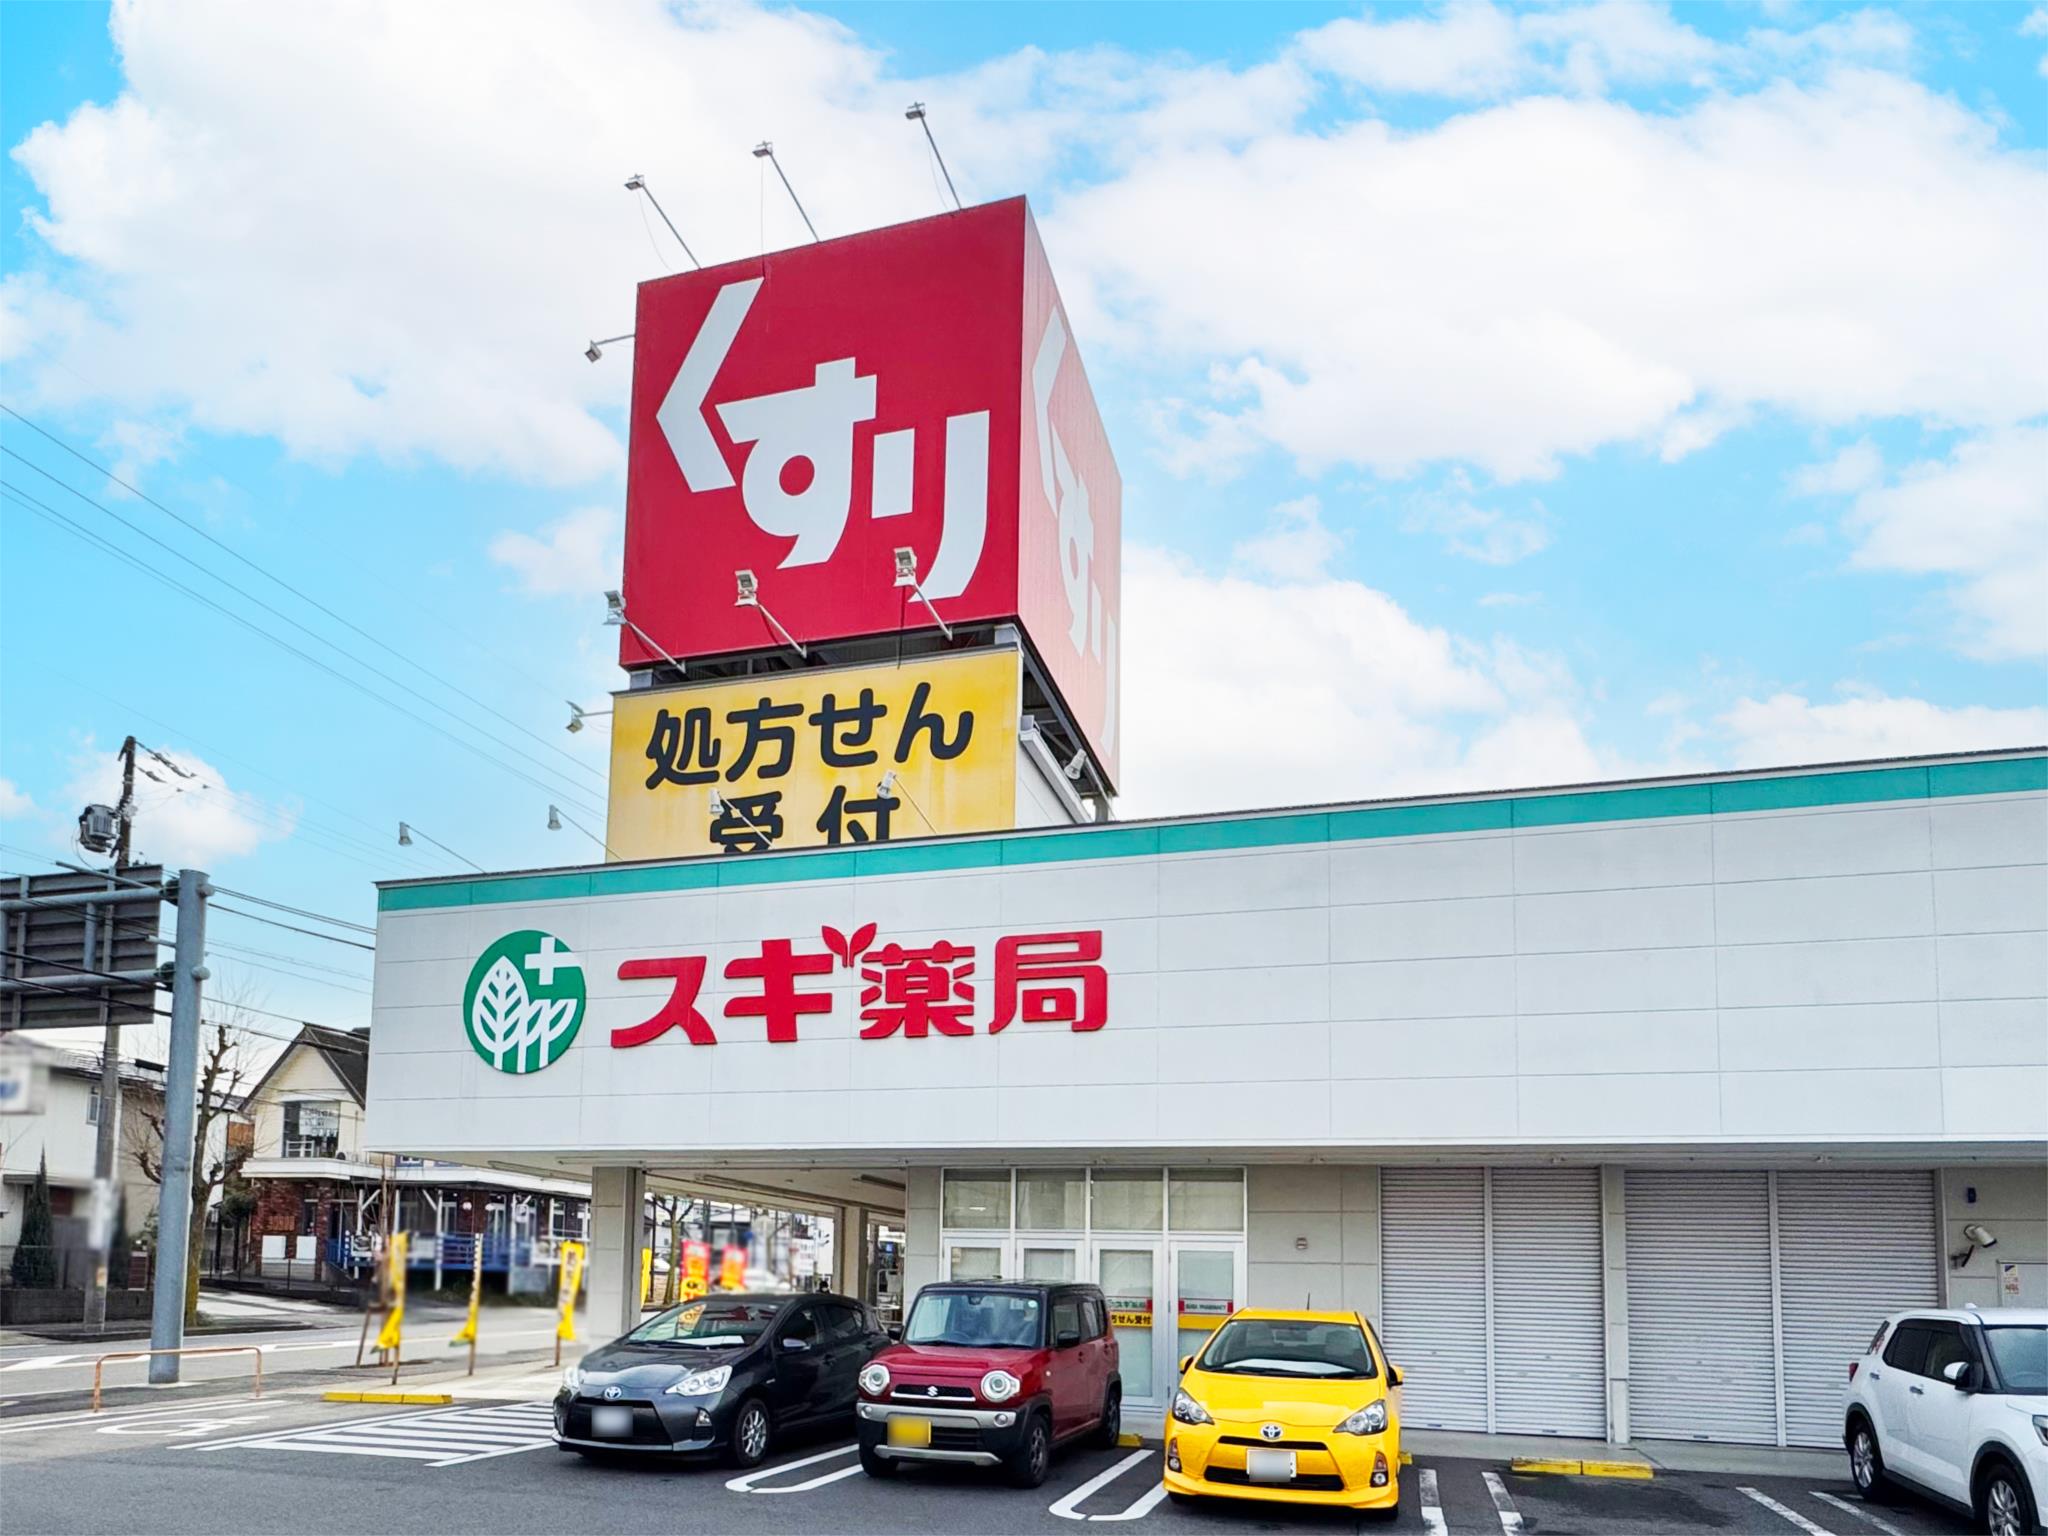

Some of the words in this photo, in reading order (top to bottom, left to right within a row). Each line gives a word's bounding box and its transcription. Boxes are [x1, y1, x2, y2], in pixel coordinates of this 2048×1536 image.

[656, 276, 990, 603] くすり
[1032, 304, 1118, 758] くすり
[646, 682, 974, 790] 処方せん
[710, 785, 900, 854] 受付
[611, 922, 1108, 1048] スギ薬局
